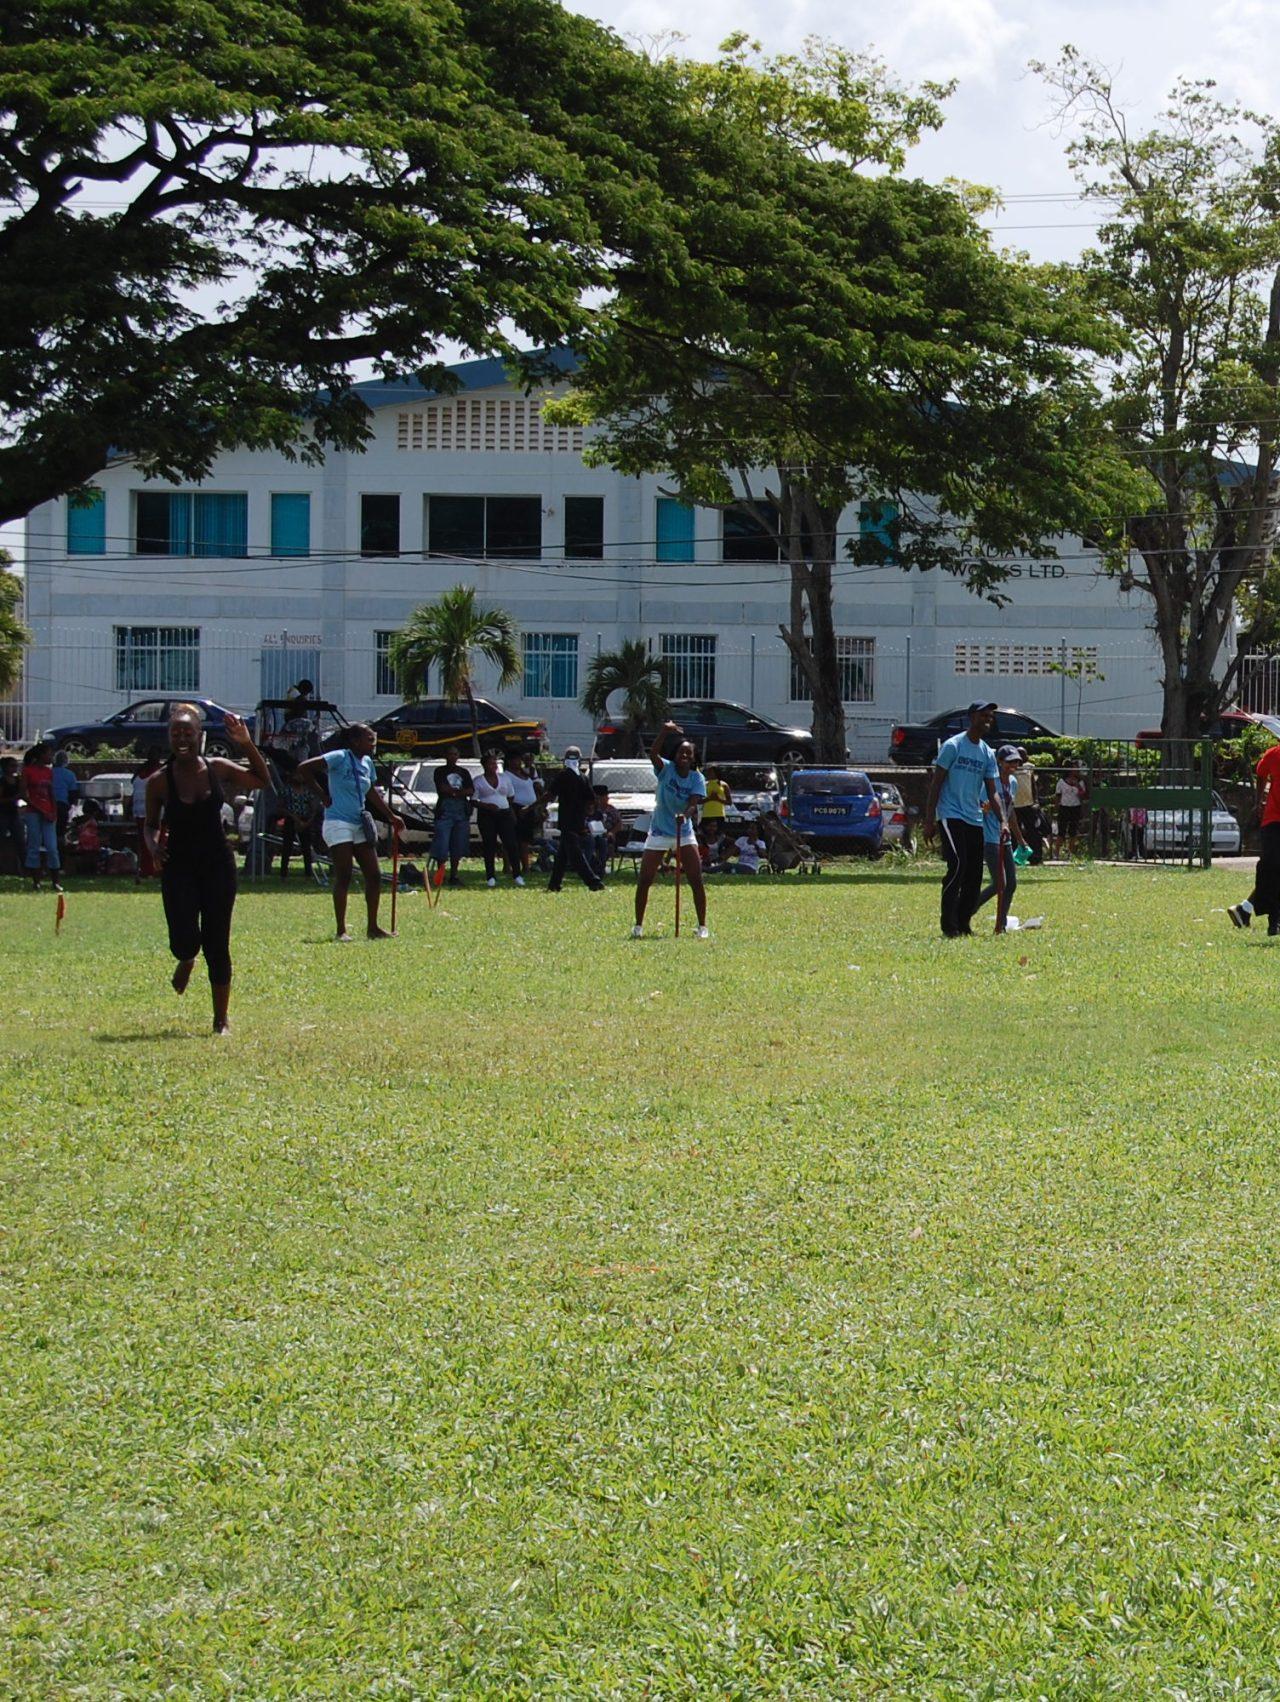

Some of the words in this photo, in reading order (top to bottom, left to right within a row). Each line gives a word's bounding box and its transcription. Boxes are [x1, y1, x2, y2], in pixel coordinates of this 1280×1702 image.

[960, 543, 1057, 558] RADIAT
[951, 563, 1022, 577] WOKS
[1029, 564, 1069, 579] LTD.
